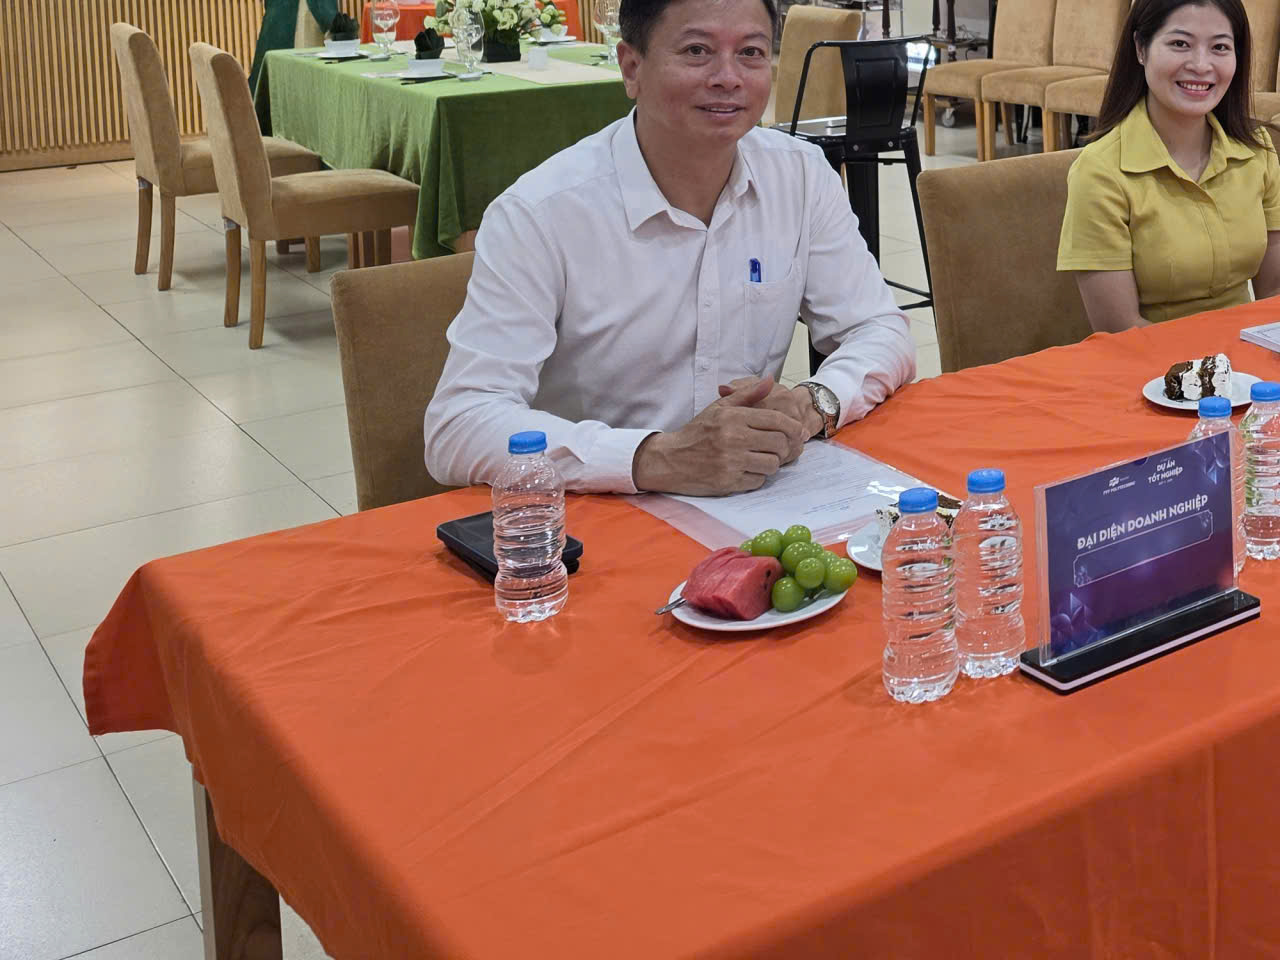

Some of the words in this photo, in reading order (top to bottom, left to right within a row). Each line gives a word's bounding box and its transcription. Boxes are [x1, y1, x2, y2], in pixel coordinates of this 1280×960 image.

[1077, 533, 1096, 549] ĐẠI
[1100, 522, 1125, 542] DIỆN
[1127, 509, 1167, 532] DOANH
[1169, 494, 1208, 518] NGHIỆP
